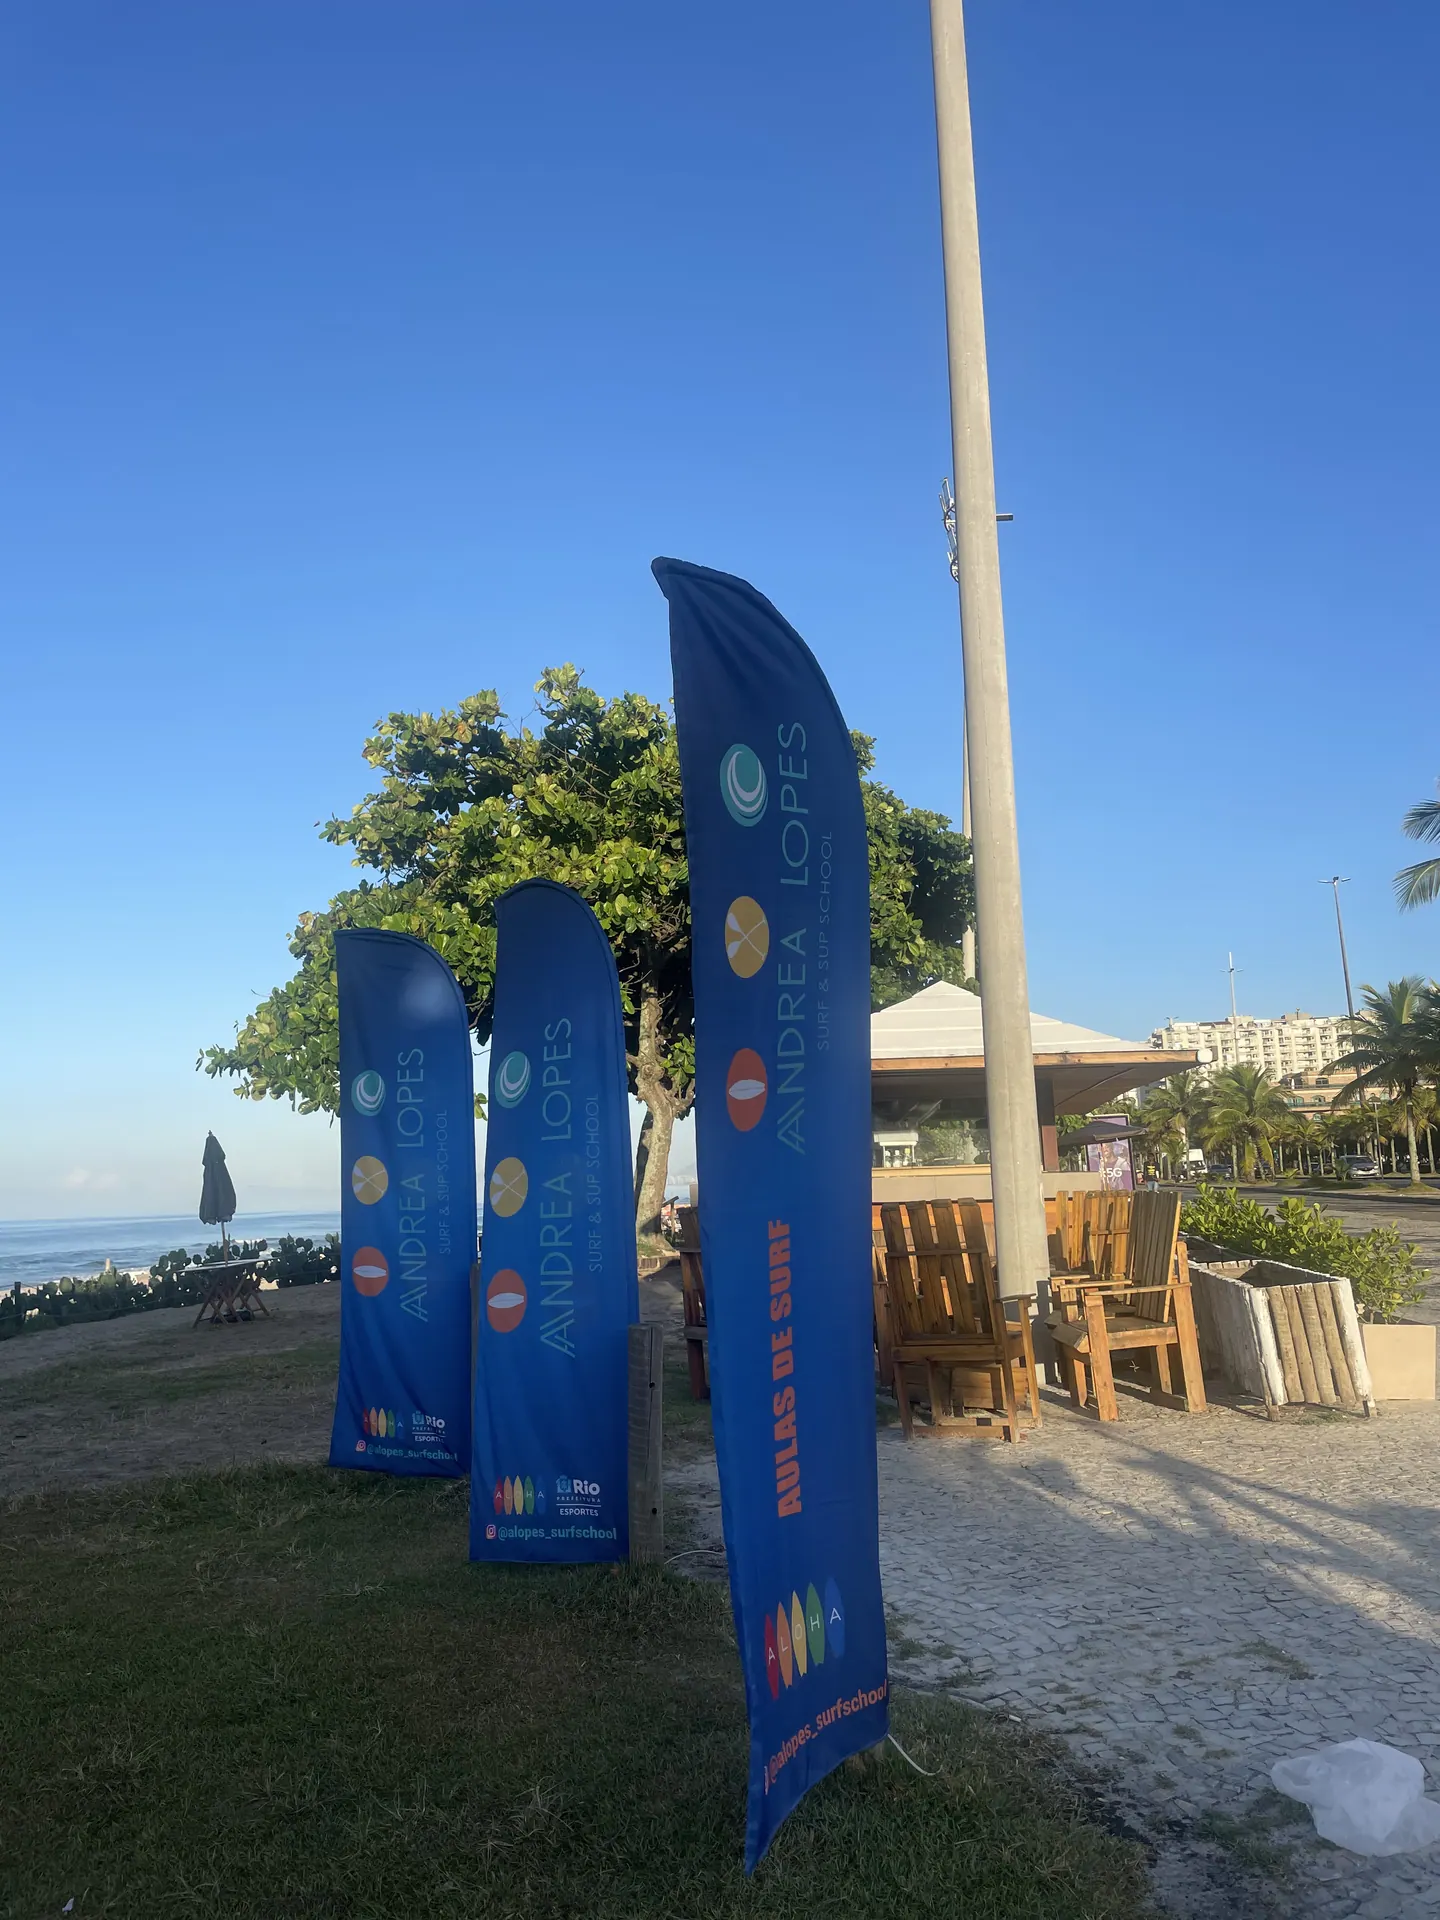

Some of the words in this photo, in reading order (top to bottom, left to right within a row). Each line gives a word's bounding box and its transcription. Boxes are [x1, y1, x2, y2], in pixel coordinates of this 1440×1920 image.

[777, 722, 809, 886] LOPES
[819, 831, 833, 925] SCHOOL
[818, 931, 829, 970] SUP
[818, 979, 829, 992] &
[777, 928, 807, 1155] ANDREA
[817, 1001, 830, 1051] SURF
[396, 1048, 424, 1148] LOPES
[540, 1017, 572, 1141] LOPES
[436, 1109, 449, 1172] SCHOOL
[585, 1093, 600, 1169] SCHOOL
[437, 1175, 449, 1201] SUP
[439, 1205, 450, 1216] &
[586, 1174, 601, 1206] SUP
[438, 1221, 451, 1255] SURF
[588, 1212, 602, 1224] &
[399, 1173, 428, 1322] ANDREA
[539, 1172, 576, 1358] ANDREA
[588, 1230, 603, 1273] SURF
[768, 1219, 792, 1322] SURF
[771, 1326, 794, 1381] DE
[425, 1414, 446, 1429] Rio
[773, 1385, 802, 1518] AULAS
[559, 1508, 599, 1517] ESPORTES
[572, 1478, 601, 1496] Rio
[497, 1525, 617, 1541] @alopes_surfschool
[768, 1607, 842, 1665] ALOHA
[769, 1678, 887, 1783] @alopes_surfschool
